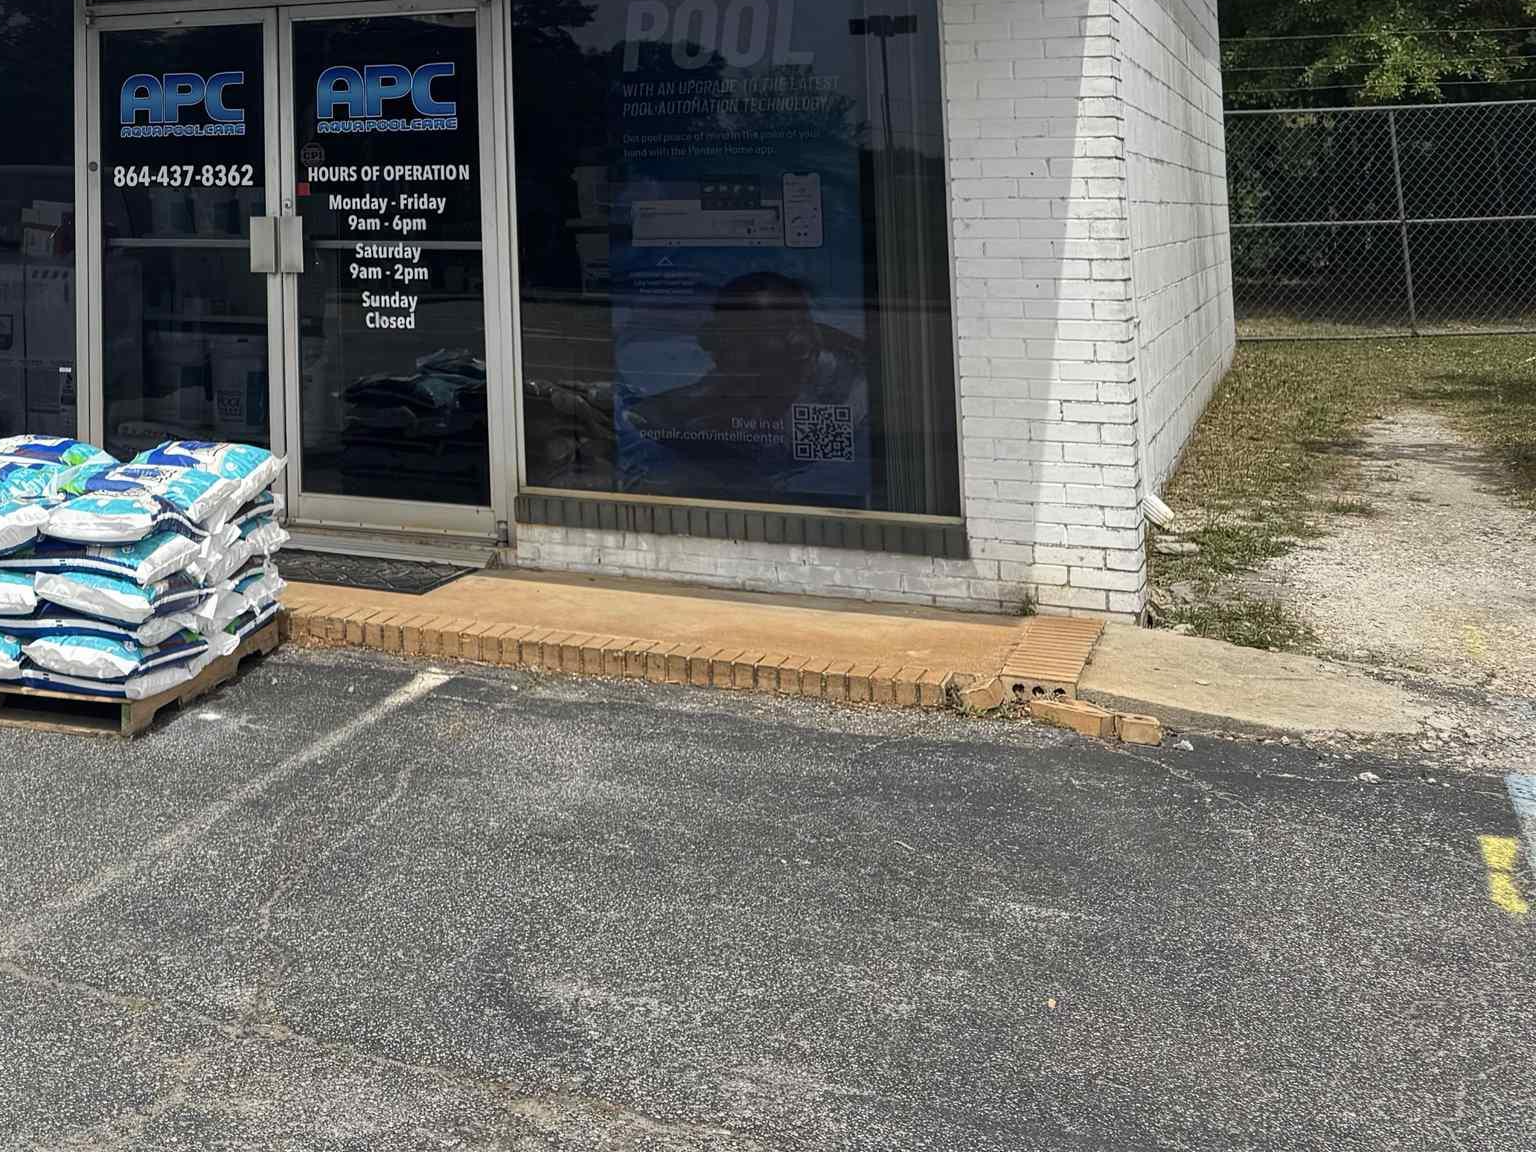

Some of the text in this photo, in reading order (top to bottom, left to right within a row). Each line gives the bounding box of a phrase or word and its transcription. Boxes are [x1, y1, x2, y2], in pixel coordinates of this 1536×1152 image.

[120, 70, 245, 124] APC
[316, 62, 457, 119] APC
[623, 83, 653, 97] WITH
[657, 82, 675, 96] AN
[678, 79, 737, 95] UPGRADE
[623, 102, 654, 117] POOL
[658, 98, 738, 115] AUTOMATION
[113, 164, 254, 187] 864-437-8362
[308, 164, 470, 182] HOURS OF OPERATION
[329, 194, 387, 214] Monday
[400, 193, 446, 214] Friday
[348, 215, 381, 230] 9am
[392, 215, 427, 235] 6pm
[355, 242, 421, 263] Saturday
[349, 263, 382, 279] 9am
[394, 264, 429, 284] 2pm
[362, 291, 418, 312] Sunday
[365, 311, 415, 329] Closed
